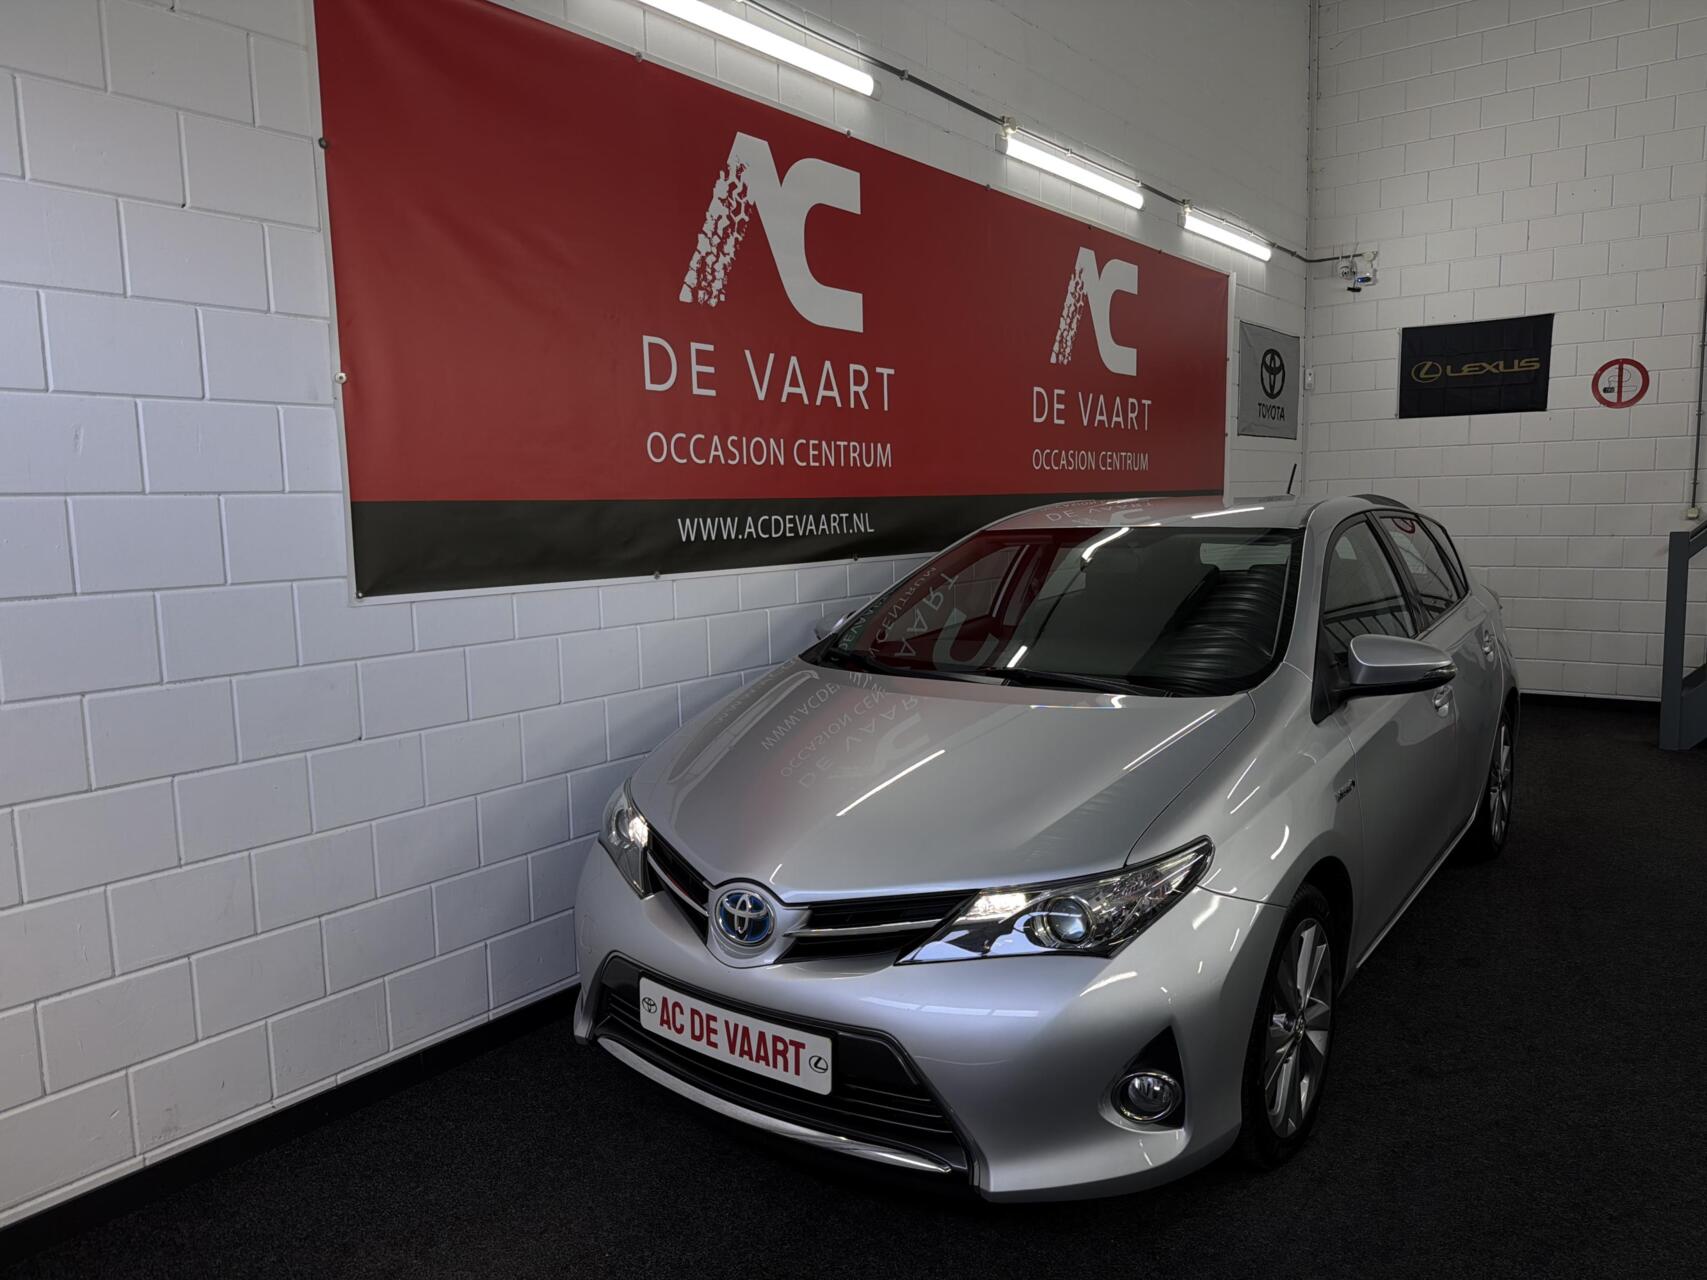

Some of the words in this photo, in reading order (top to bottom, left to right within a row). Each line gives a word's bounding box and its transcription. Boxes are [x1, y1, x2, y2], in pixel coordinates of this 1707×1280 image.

[679, 131, 864, 333] AC
[642, 334, 717, 398] DE
[744, 348, 896, 412] VAART
[1446, 357, 1541, 377] LEXUS
[1032, 386, 1066, 426] DE
[1078, 391, 1153, 432] VAART
[1257, 402, 1286, 421] TOYOTA
[646, 431, 785, 467] OCCASION
[793, 438, 893, 468] CENTRUM
[1032, 448, 1096, 471] OCCASION
[1099, 450, 1150, 472] CENTRUM
[677, 512, 875, 543] WWW.ACDEVAART.NL
[659, 995, 685, 1036] AC
[690, 1008, 719, 1050] DE
[724, 1018, 806, 1077] VAART
